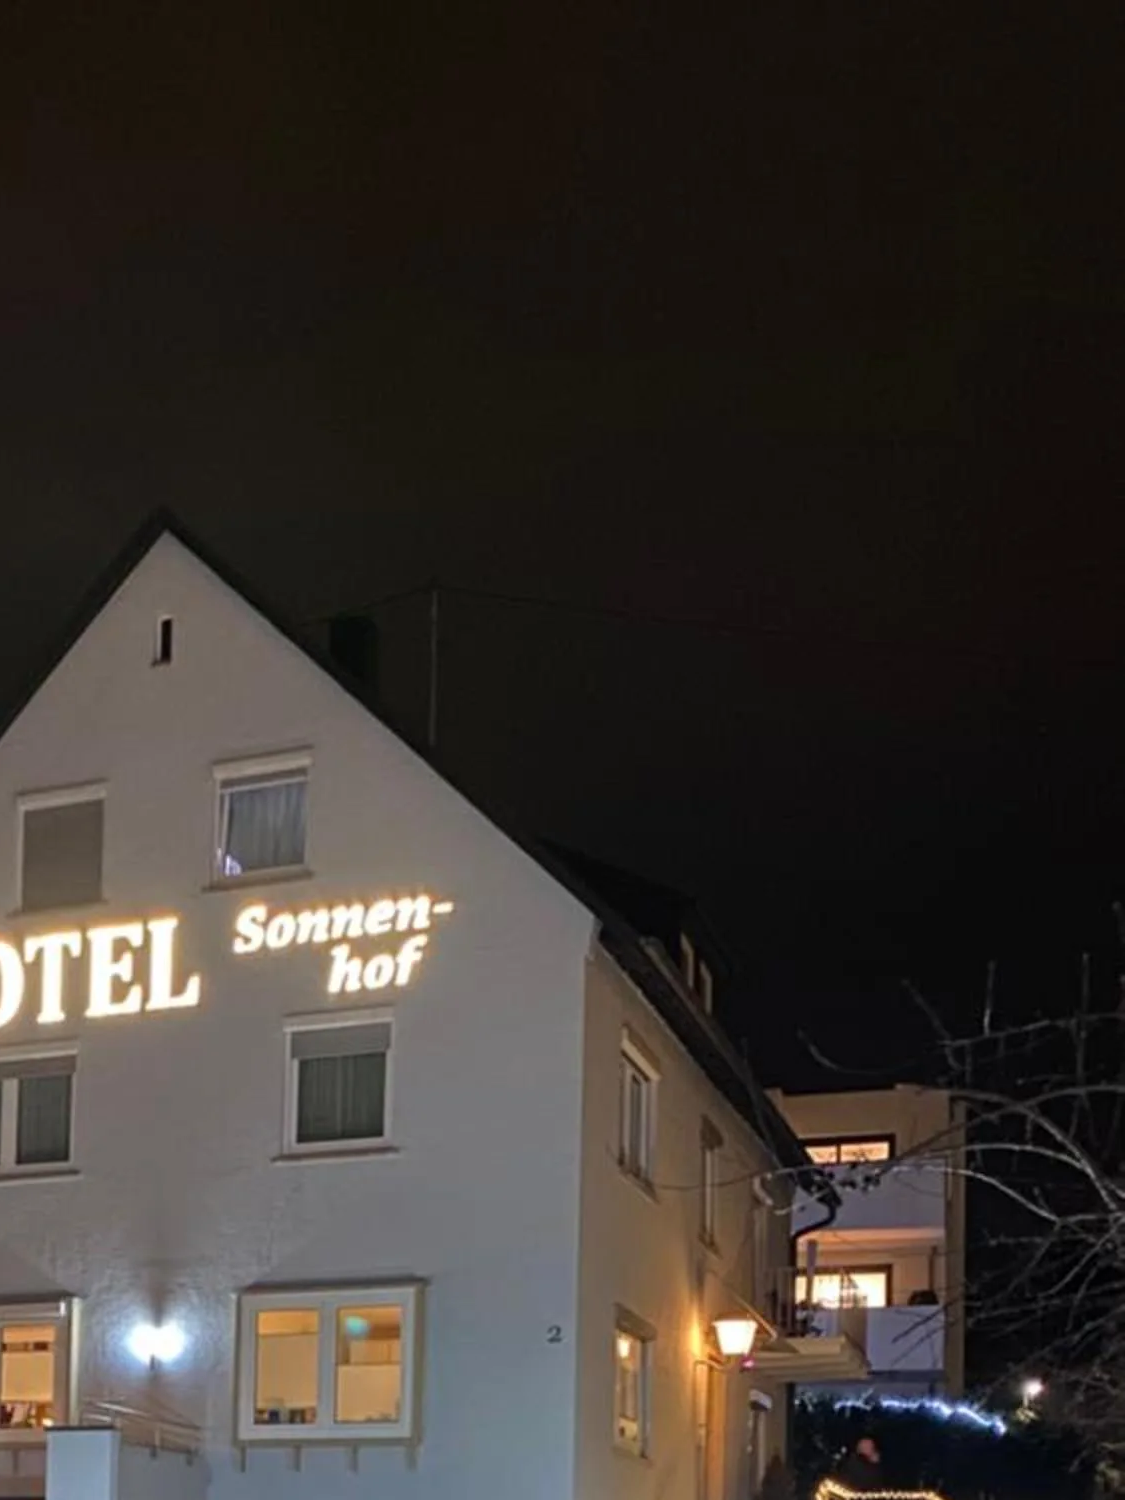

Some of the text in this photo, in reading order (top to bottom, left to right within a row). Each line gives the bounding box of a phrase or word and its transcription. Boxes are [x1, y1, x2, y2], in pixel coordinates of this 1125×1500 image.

[232, 893, 454, 954] Sonnen-
[326, 937, 427, 994] hof
[546, 1324, 563, 1345] 2
